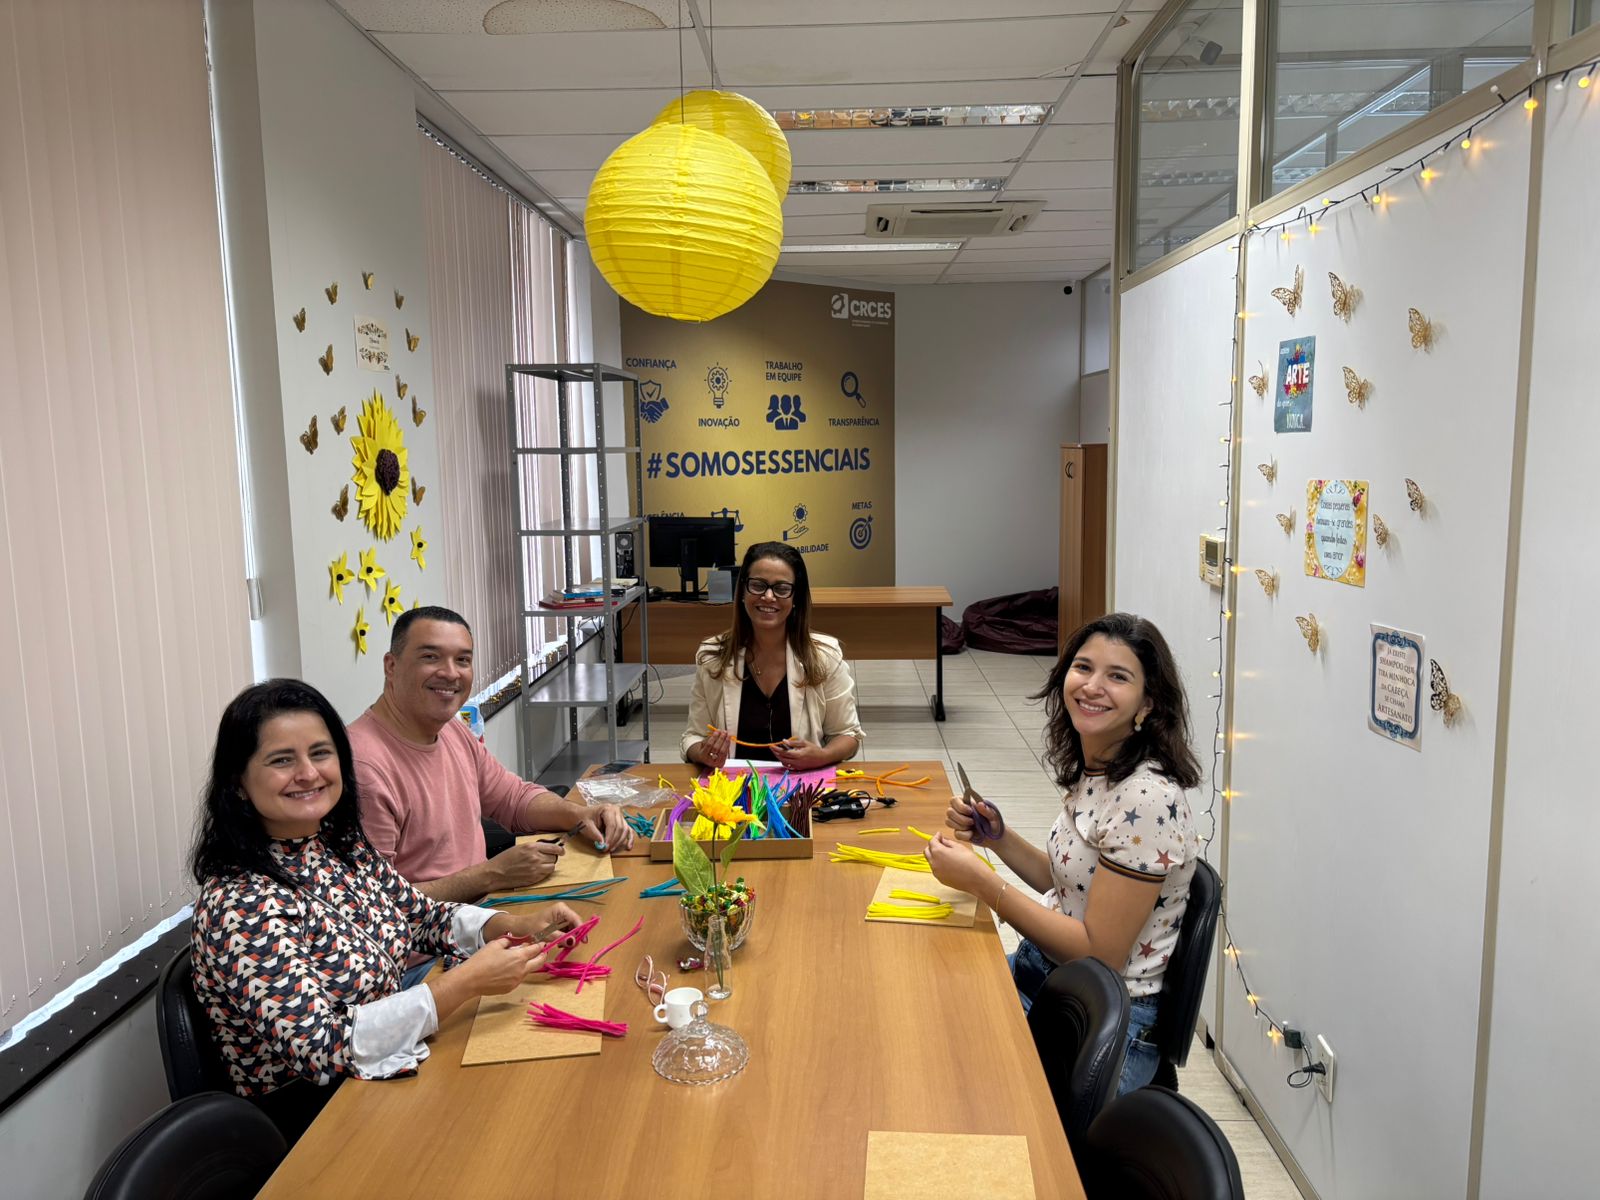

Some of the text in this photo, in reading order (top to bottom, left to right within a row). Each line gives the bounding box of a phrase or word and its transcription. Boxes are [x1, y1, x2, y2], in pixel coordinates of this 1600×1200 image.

[850, 300, 892, 319] CRCES
[625, 358, 677, 371] CONFIANÇA
[765, 361, 803, 371] TRABALHO
[765, 372, 802, 383] EM EQUIPE
[1285, 362, 1310, 385] ARTE
[698, 417, 740, 429] INOVAÇÃO
[828, 417, 880, 427] TRANSPARÊNCIA
[647, 447, 871, 479] #SOMOSESSENCIAIS
[851, 501, 873, 510] METAS
[1393, 649, 1406, 659] EXISTE
[1379, 656, 1415, 675] SHAMPOO QUE
[1378, 668, 1416, 687] TIRA MINHOCA
[1388, 684, 1408, 699] CABEÇA
[1390, 697, 1406, 709] CHAMA
[1377, 704, 1412, 723] ARTESANATO
